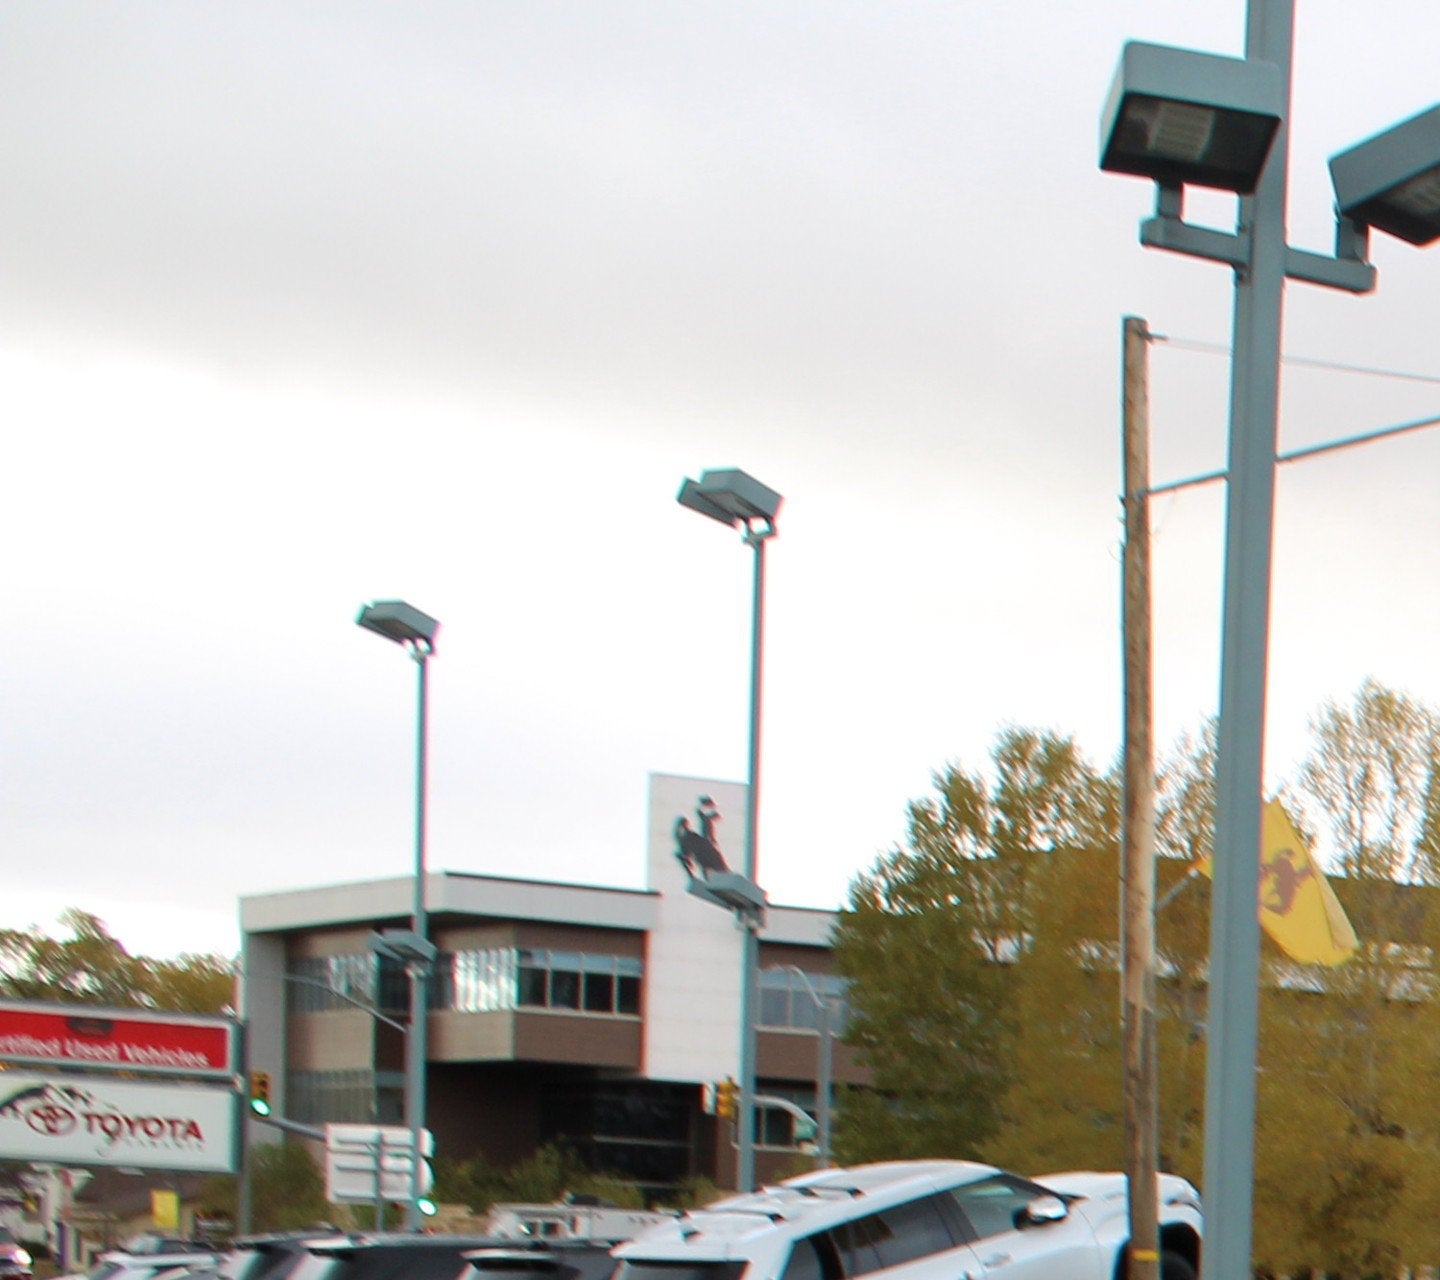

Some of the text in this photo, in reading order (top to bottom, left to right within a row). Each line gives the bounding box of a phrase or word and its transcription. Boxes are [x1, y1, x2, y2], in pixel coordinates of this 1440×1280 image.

[63, 1037, 121, 1062] Used
[121, 1042, 210, 1069] Vehicles
[81, 1111, 206, 1144] TOYOTA
